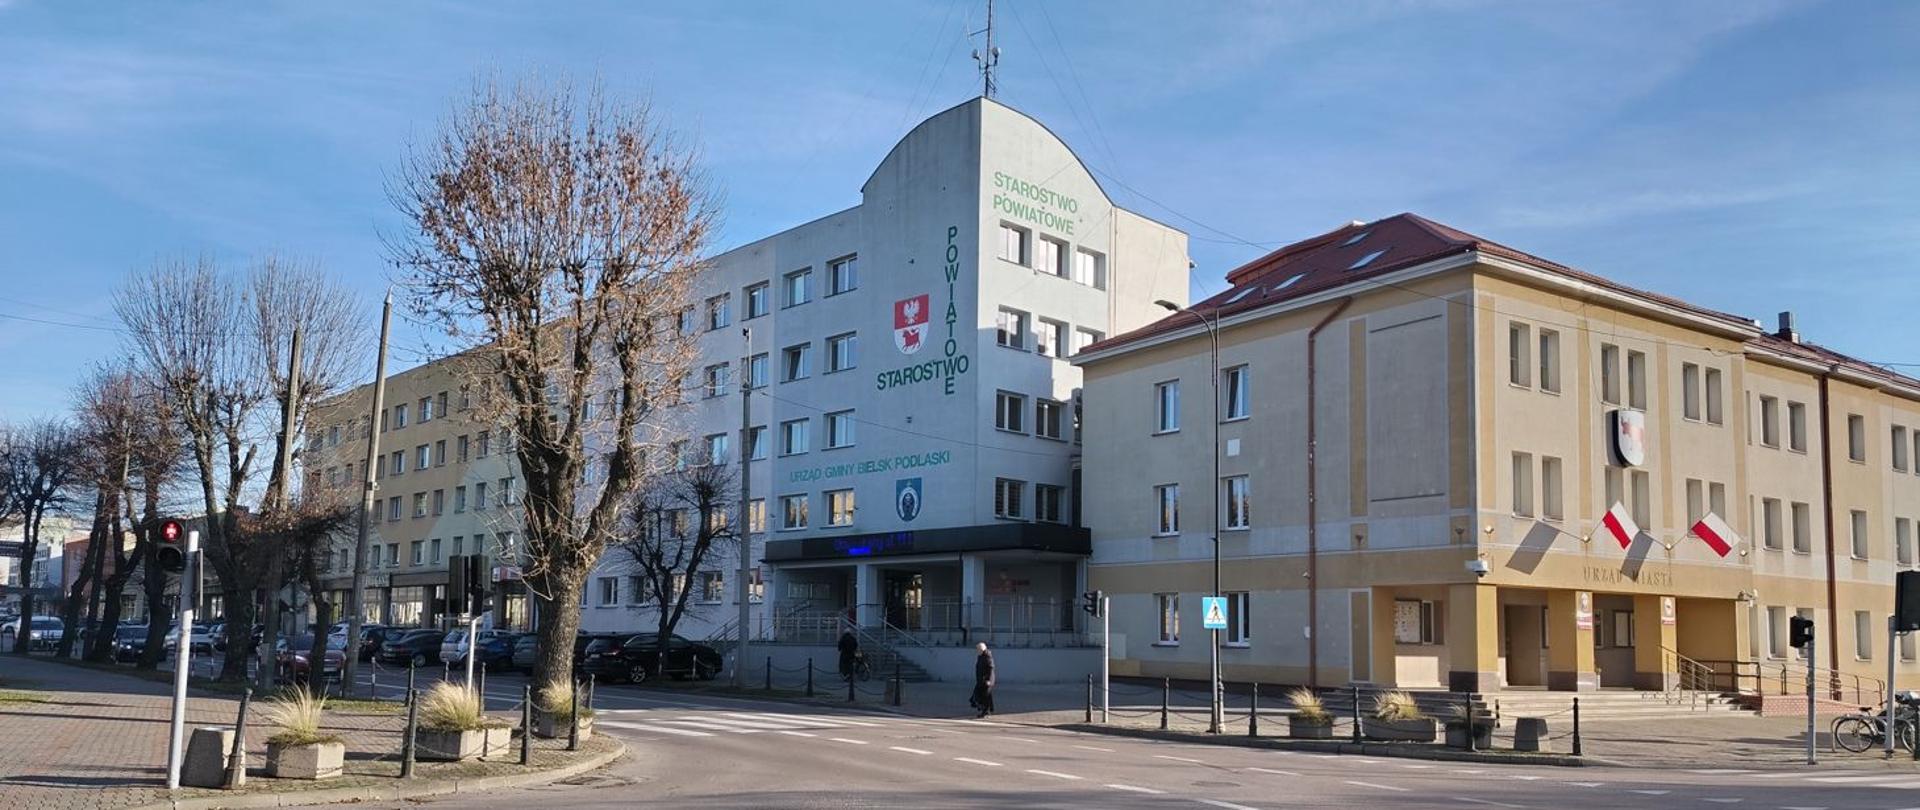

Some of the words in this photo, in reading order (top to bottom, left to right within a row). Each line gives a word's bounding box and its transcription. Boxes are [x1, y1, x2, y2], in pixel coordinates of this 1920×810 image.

[994, 171, 1078, 214] STAROSTWO
[993, 194, 1075, 236] POWIATOWE
[944, 226, 959, 395] POWIATOWE
[877, 355, 969, 391] STAROSTWO
[825, 463, 855, 479] GMINY
[857, 458, 893, 474] BIELSK
[895, 450, 950, 469] PODLASKI
[1632, 570, 1673, 586] MIASTA
